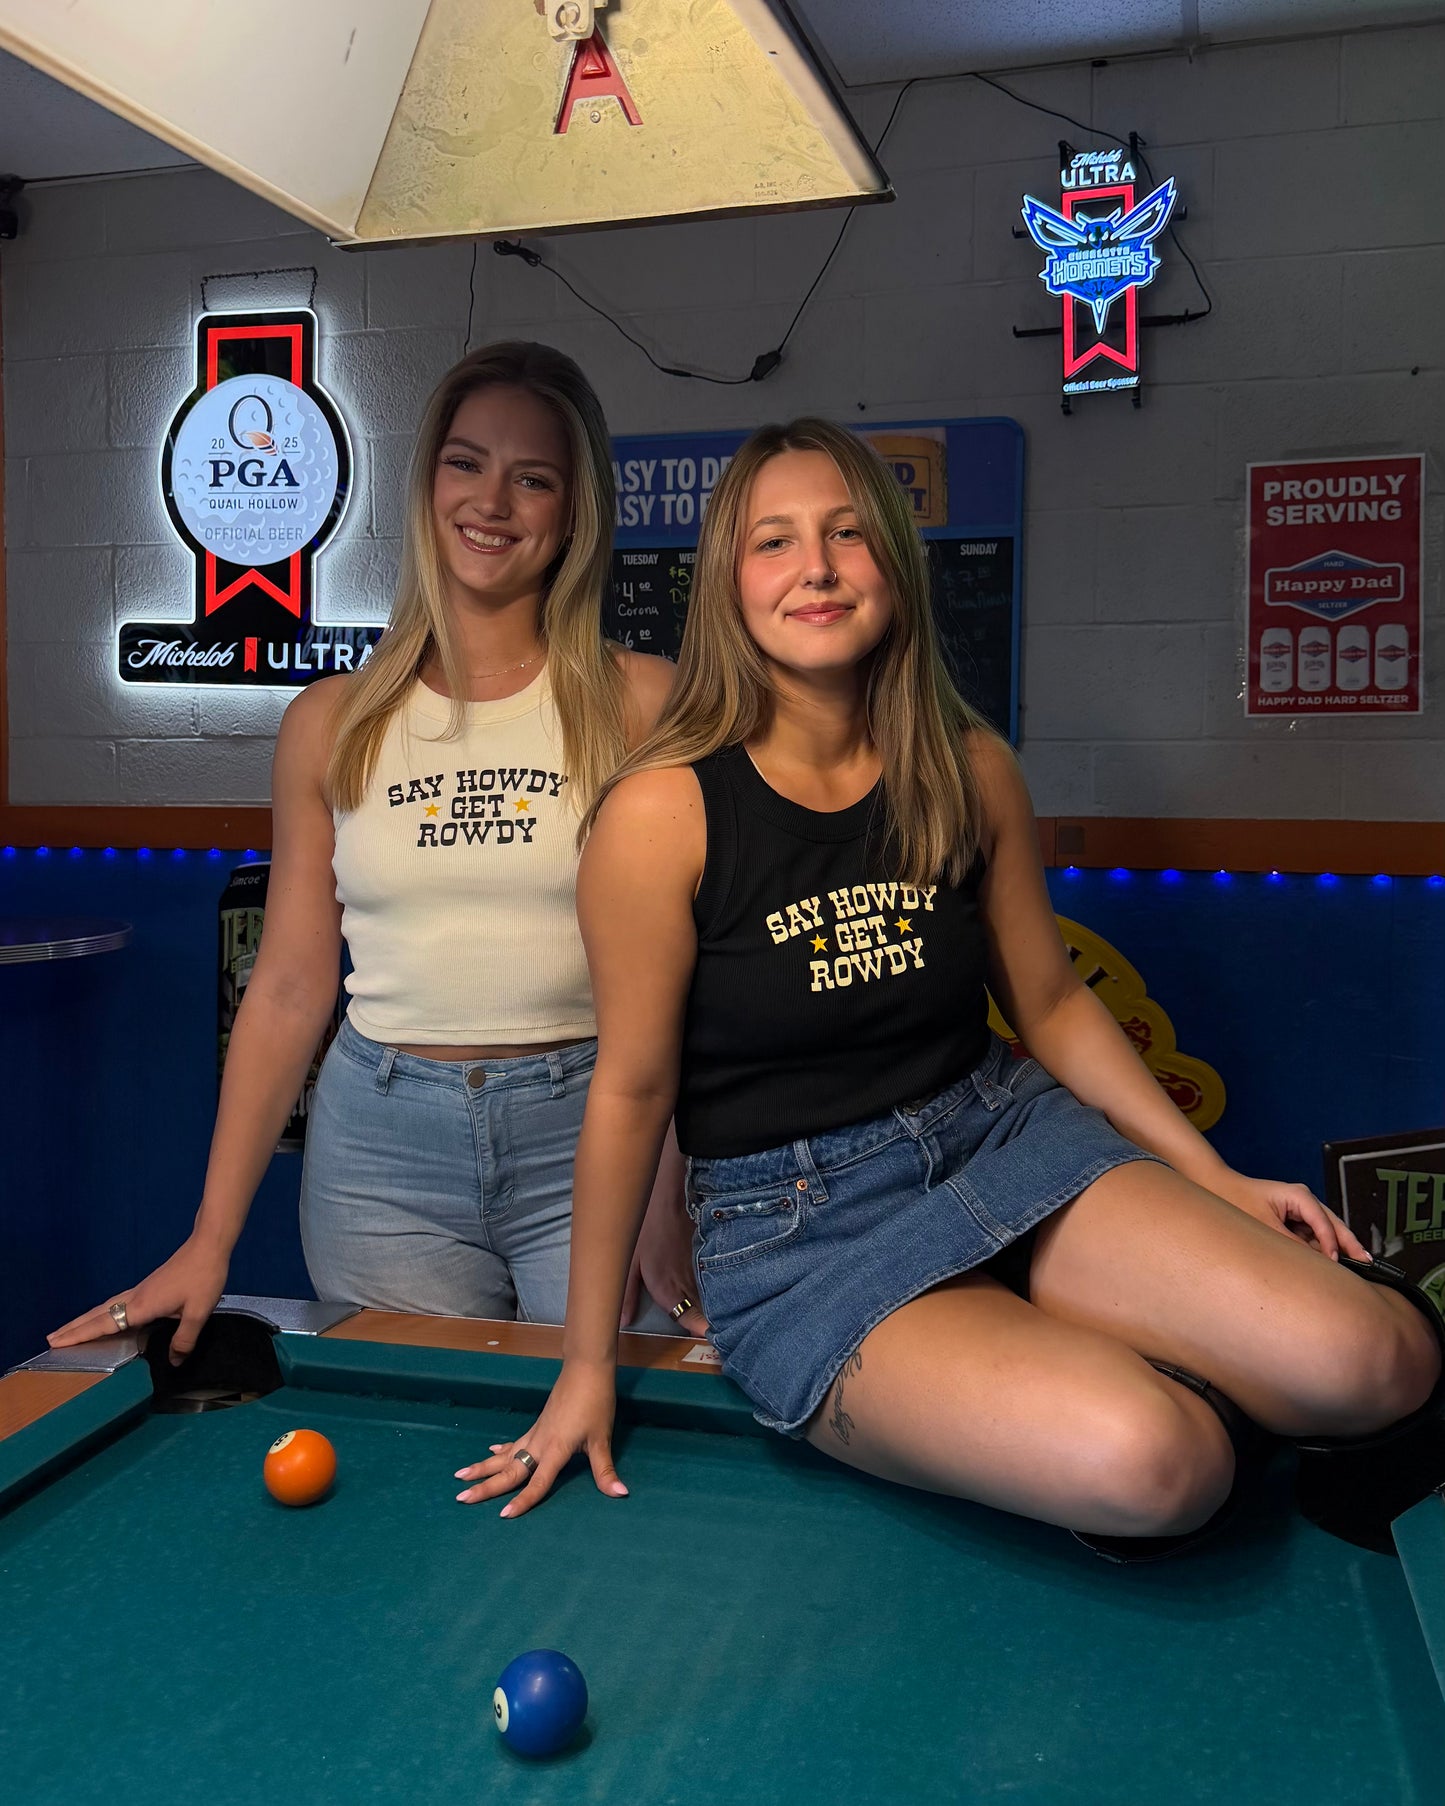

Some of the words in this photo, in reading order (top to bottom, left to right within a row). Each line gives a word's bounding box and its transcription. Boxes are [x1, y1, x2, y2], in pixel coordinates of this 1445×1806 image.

[1060, 162, 1136, 188] ULTRA
[1052, 251, 1148, 286] HORNETS
[1107, 376, 1139, 389] Sponsor
[211, 438, 225, 449] 20
[284, 436, 298, 448] 25
[208, 458, 300, 488] PGA
[613, 459, 658, 493] ASY
[661, 457, 696, 491] TO
[1263, 473, 1406, 502] PROUDLY
[209, 499, 244, 510] QUAIL
[248, 498, 298, 510] HOLLOW
[615, 494, 656, 527] ASY
[660, 492, 695, 526] TO
[1266, 499, 1402, 527] SERVING
[205, 527, 265, 541] OFFICIAL
[268, 527, 304, 541] BEER
[622, 553, 659, 566] TUESDAY
[960, 543, 998, 557] SUNDAY
[1323, 560, 1344, 568] HARD
[1275, 579, 1346, 594] Happy
[1350, 575, 1393, 589] Dad
[617, 603, 660, 617] Corona
[1318, 601, 1348, 610] SELTZER
[127, 639, 239, 669] Michelob
[1257, 696, 1296, 706] HAPPY
[1298, 696, 1322, 705] DAD
[1325, 695, 1357, 705] HARD
[1360, 694, 1409, 705] SELTZER
[387, 773, 444, 807] SAY
[456, 768, 569, 797] HOWDY
[451, 794, 505, 819] GET
[417, 817, 537, 848] ROWDY
[766, 896, 825, 945] SAY
[827, 881, 938, 920] HOWDY
[834, 914, 888, 953] GET
[809, 937, 926, 992] ROWDY
